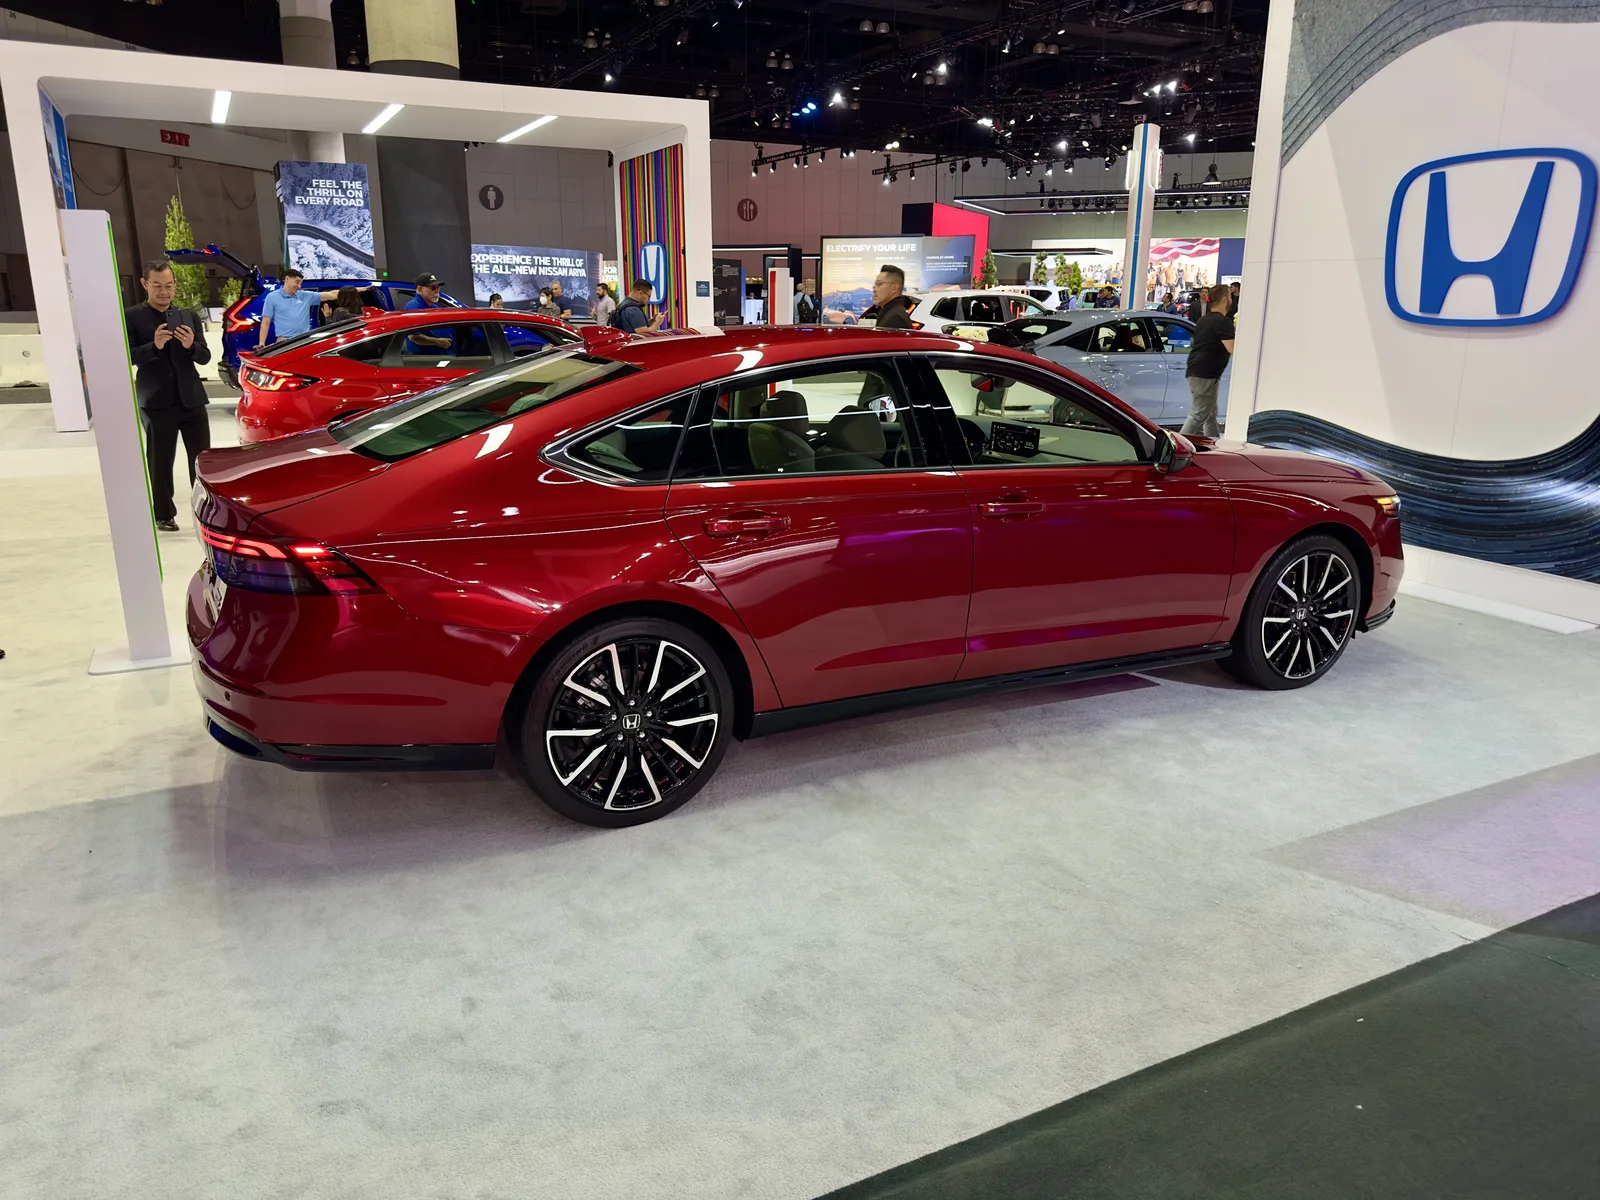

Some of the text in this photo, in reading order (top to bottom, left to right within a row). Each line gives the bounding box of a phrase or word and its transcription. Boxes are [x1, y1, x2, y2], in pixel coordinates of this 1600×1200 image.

[312, 179, 362, 189] FEEL THE
[306, 188, 363, 198] THRILL ON
[295, 196, 364, 207] EVERY ROAD
[826, 243, 917, 252] ELECTRIFY YOUR LIFE
[533, 255, 551, 266] THE
[551, 257, 575, 267] THRILL
[575, 258, 584, 268] OF
[492, 264, 538, 275] ALL-NEW
[538, 266, 568, 277] NISSAN
[568, 268, 587, 277] ARIYA
[604, 266, 618, 274] FOR
